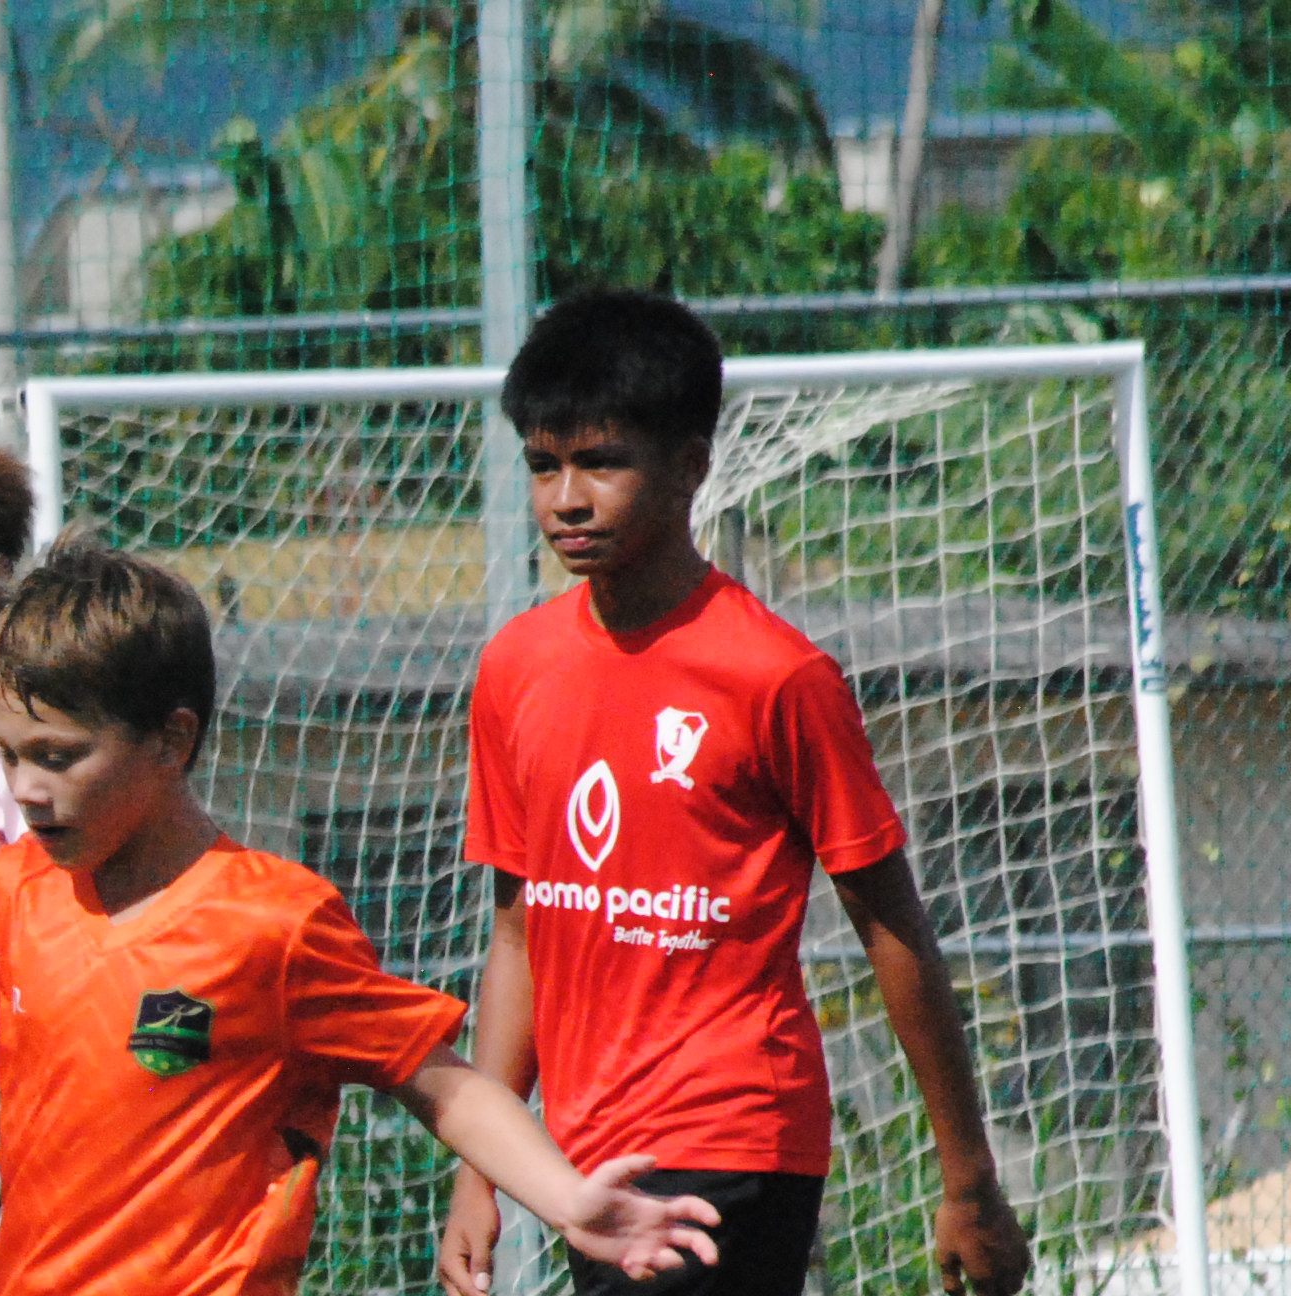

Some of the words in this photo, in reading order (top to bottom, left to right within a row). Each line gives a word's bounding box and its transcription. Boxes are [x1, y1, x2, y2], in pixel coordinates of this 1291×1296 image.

[606, 883, 731, 924] pacific
[613, 925, 655, 946] Better
[657, 928, 716, 956] Together
